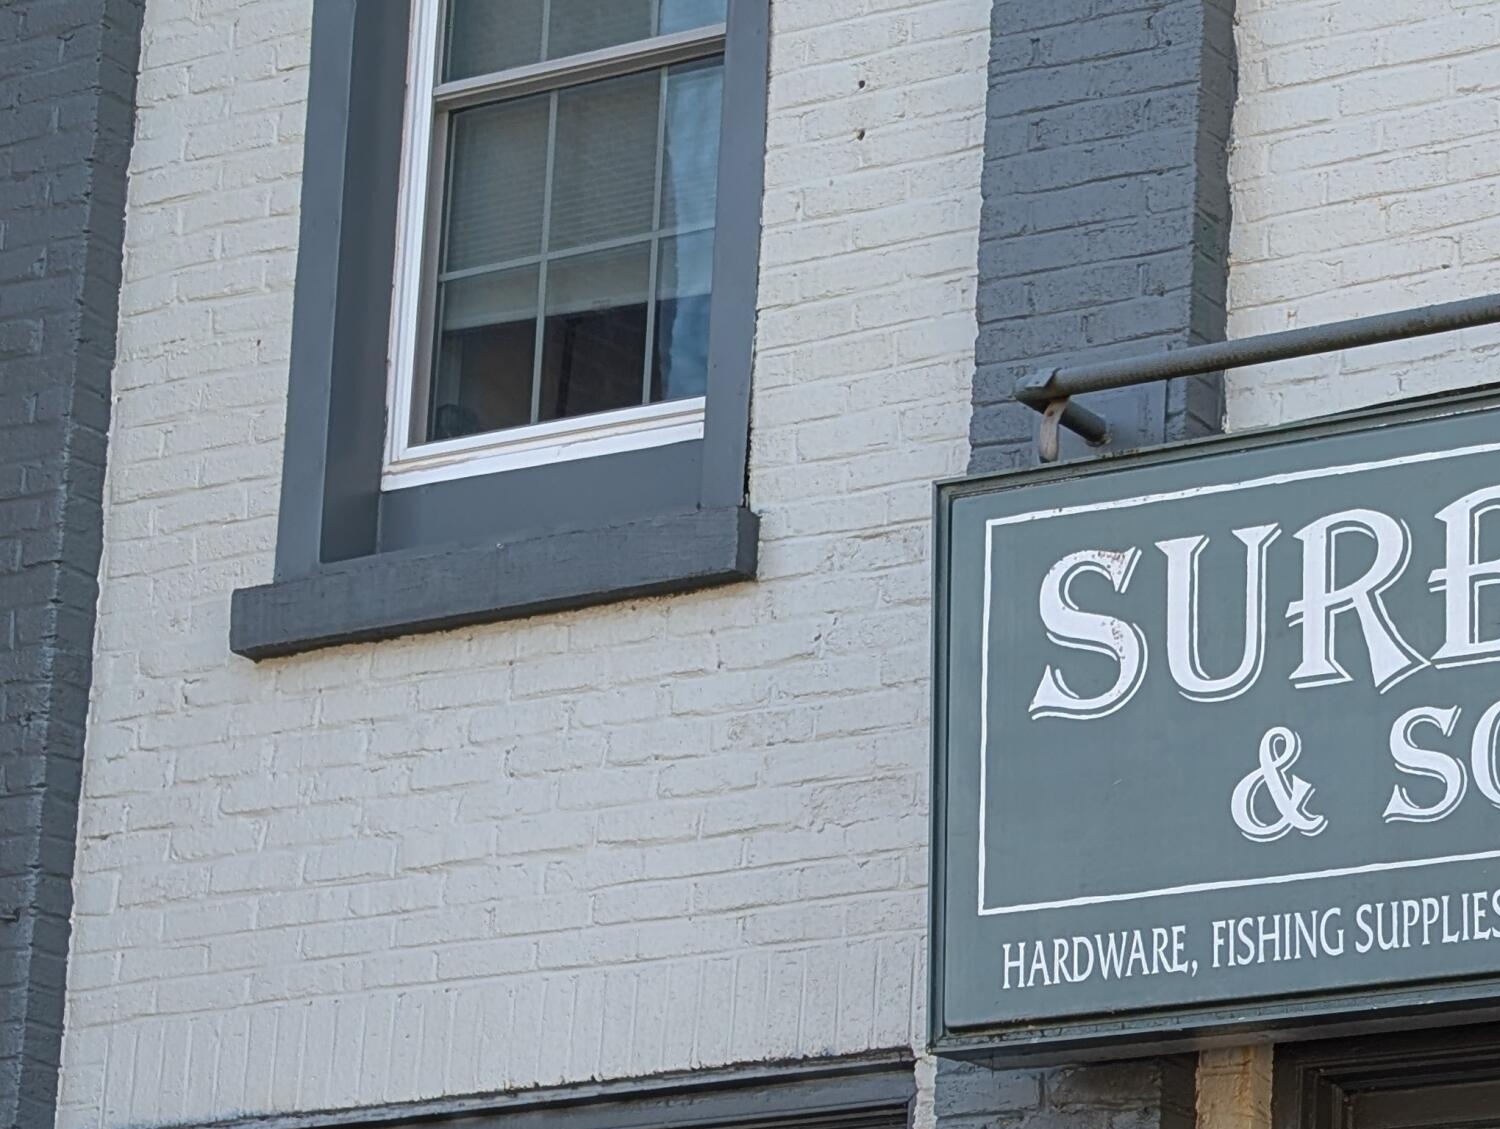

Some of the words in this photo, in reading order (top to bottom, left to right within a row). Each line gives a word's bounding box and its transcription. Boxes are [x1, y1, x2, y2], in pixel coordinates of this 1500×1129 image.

[1231, 726, 1327, 842] &
[1002, 925, 1198, 989] HARDWARE,
[1212, 907, 1345, 969] FISHING
